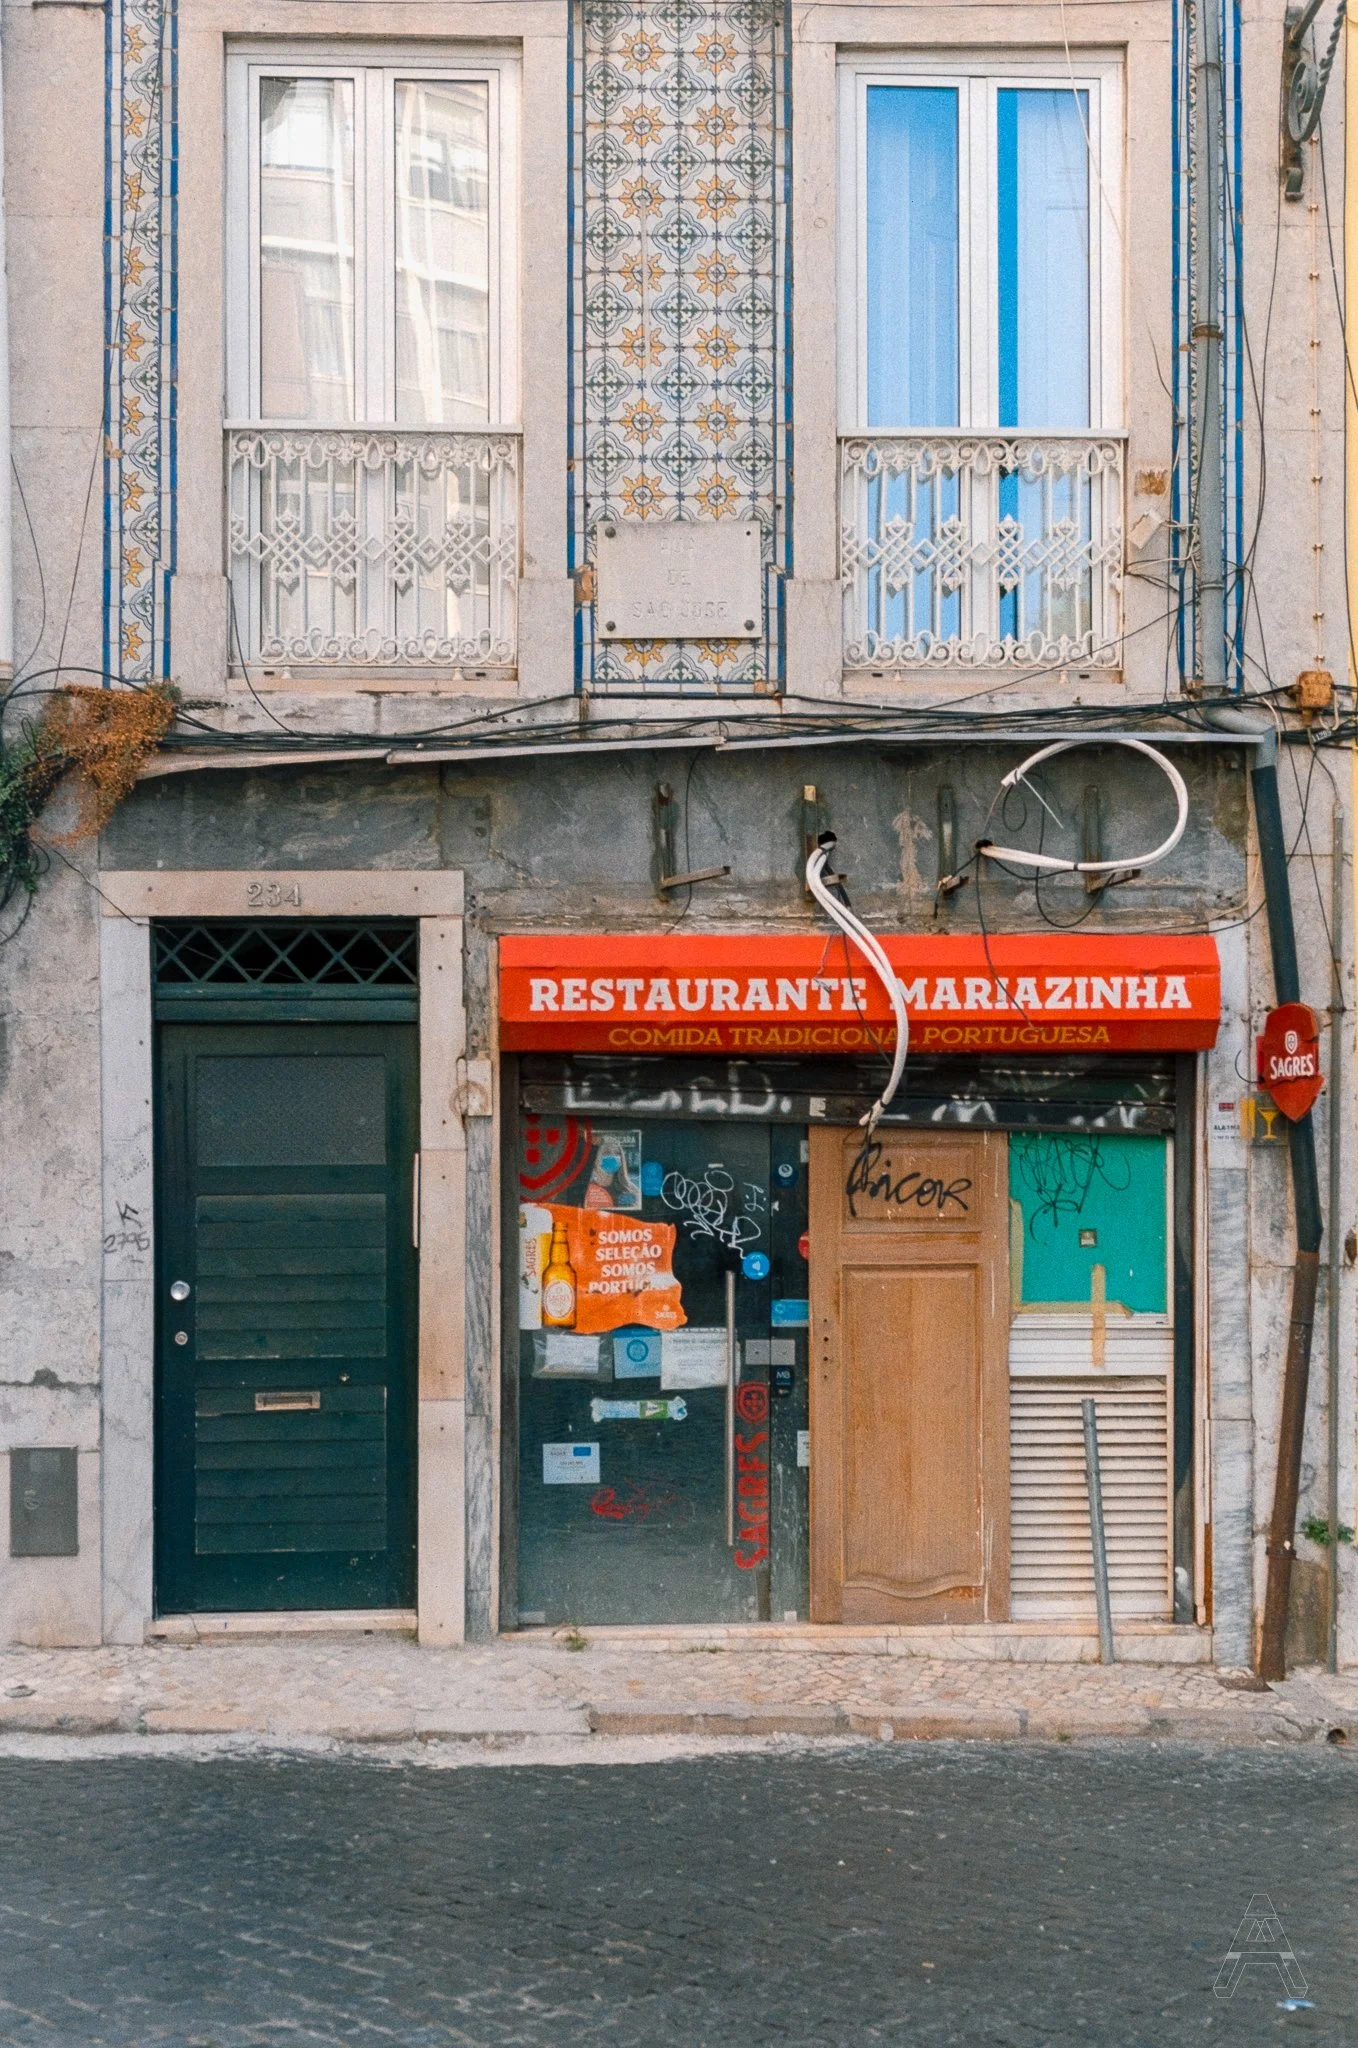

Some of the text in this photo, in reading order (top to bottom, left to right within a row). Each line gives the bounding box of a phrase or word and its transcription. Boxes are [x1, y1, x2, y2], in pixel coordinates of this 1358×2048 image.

[247, 883, 302, 907] 234
[530, 976, 1192, 1011] RESTAURANTE MARIAZINHA
[609, 1028, 722, 1047] COMIDA
[924, 1026, 1110, 1046] PORTUGUESA
[1270, 1054, 1315, 1079] SAGRES
[598, 1229, 652, 1244] SOMOS
[525, 1238, 537, 1277] SAGRES
[595, 1243, 662, 1261] SELEÇÃO
[601, 1262, 656, 1277] SOMOS
